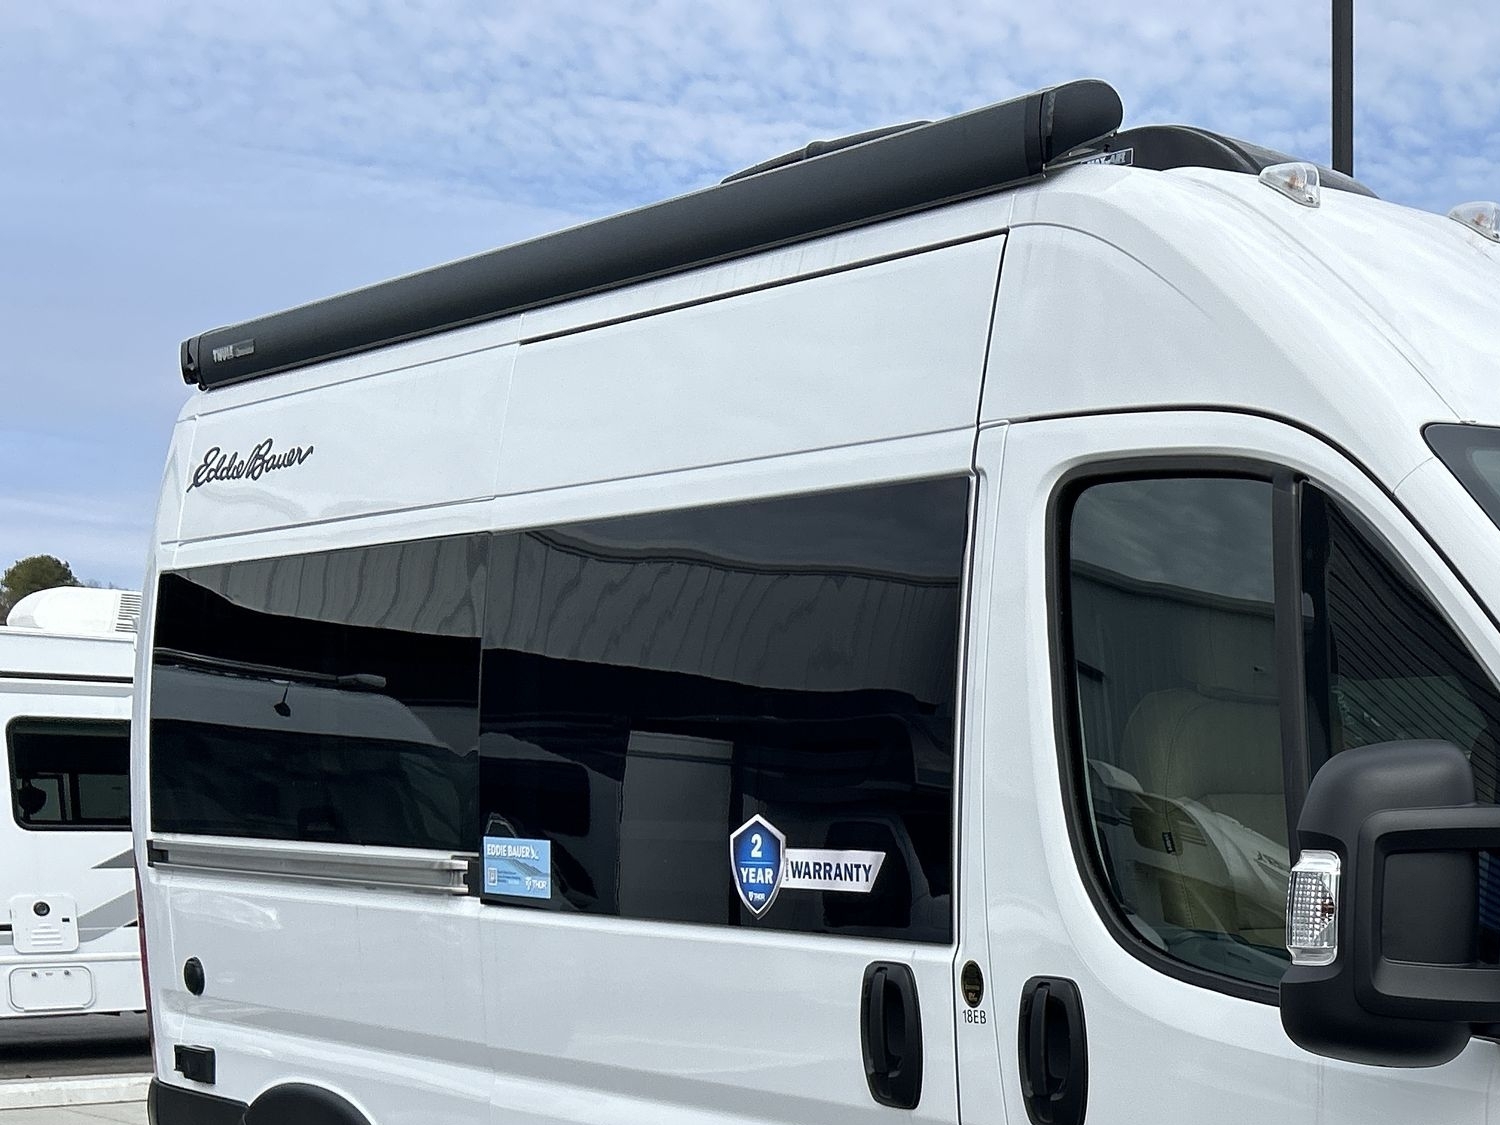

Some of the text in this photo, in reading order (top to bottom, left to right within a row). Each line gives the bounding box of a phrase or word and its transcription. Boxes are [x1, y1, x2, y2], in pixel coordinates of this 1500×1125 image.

[487, 844, 531, 858] EDDIE BAUER
[750, 833, 763, 858] 2
[740, 867, 774, 885] YEAR
[790, 860, 872, 883] WARRANTY
[962, 1009, 987, 1024] 18EB
